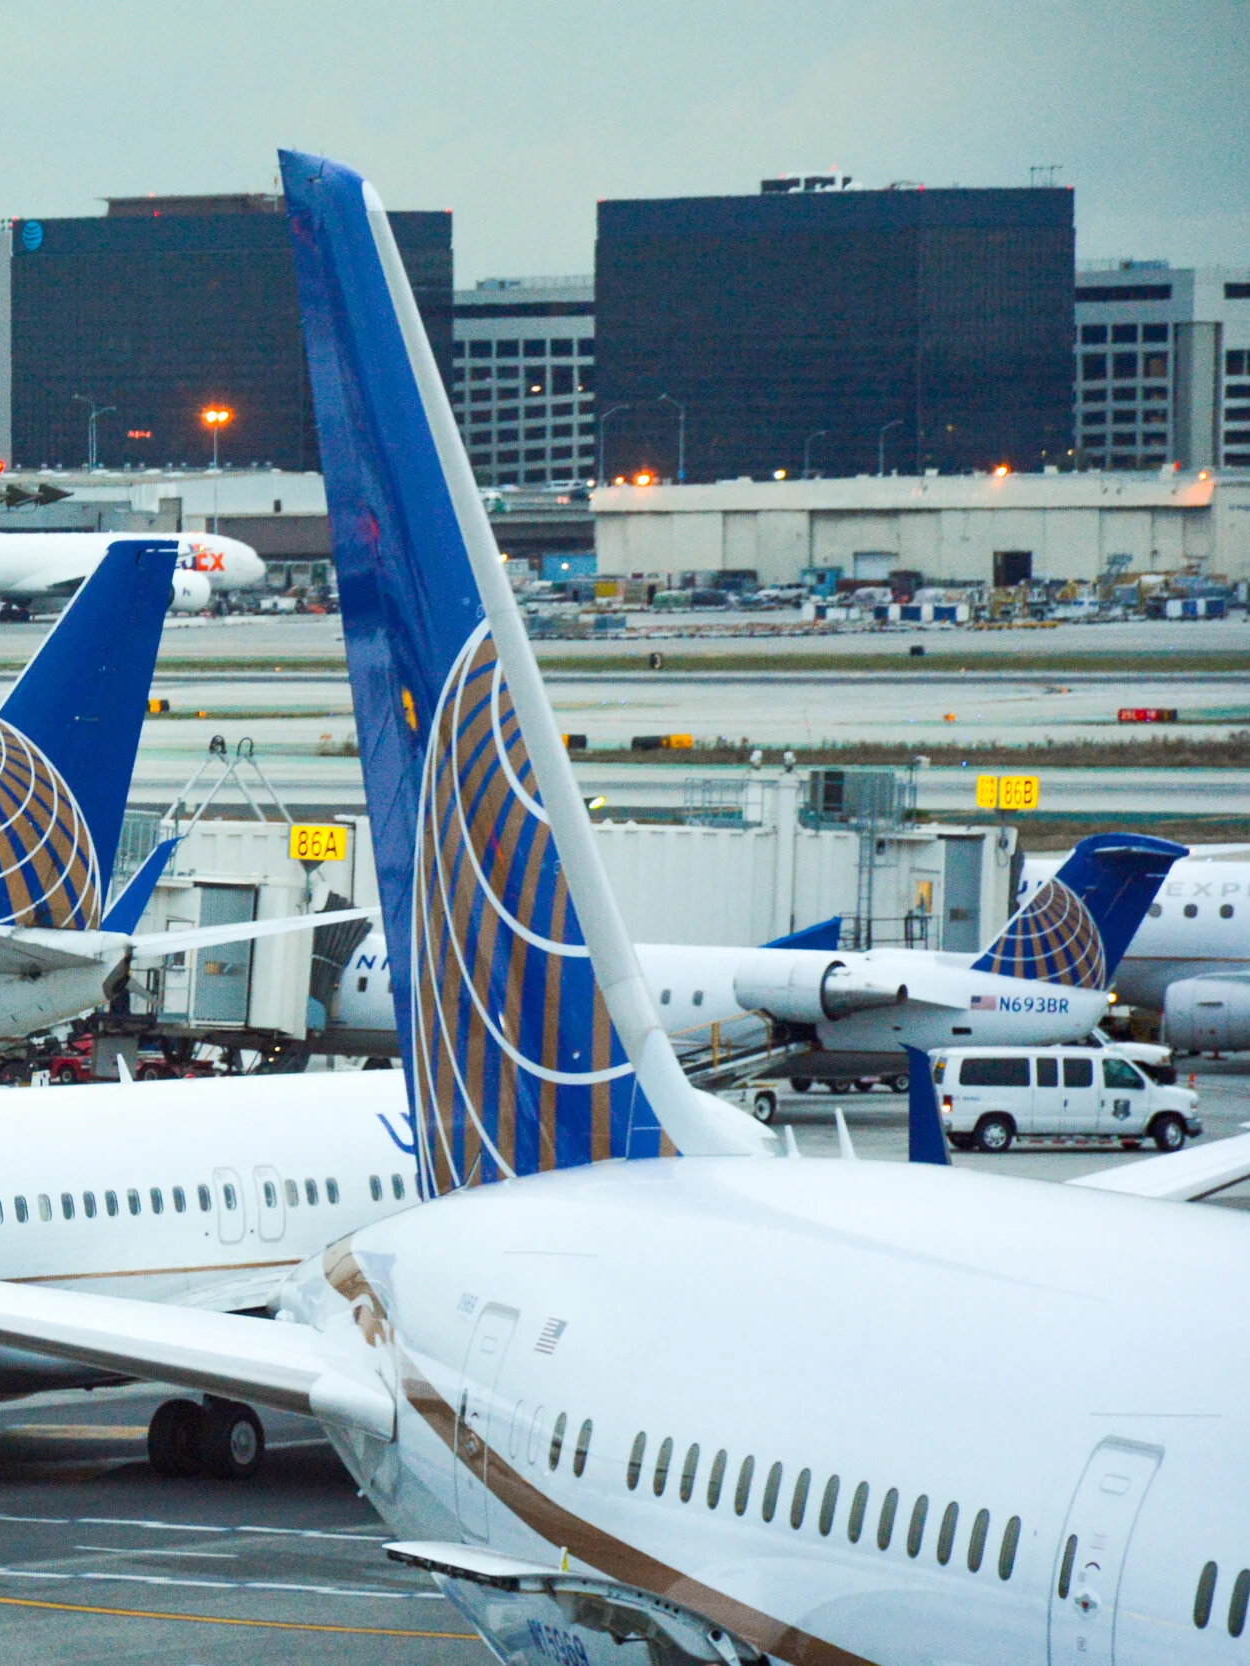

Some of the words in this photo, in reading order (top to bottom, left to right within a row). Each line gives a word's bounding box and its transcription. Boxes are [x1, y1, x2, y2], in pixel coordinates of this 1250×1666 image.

[1004, 780, 1033, 804] 86B
[297, 830, 338, 857] 86A
[1166, 881, 1250, 898] EXP
[999, 996, 1069, 1013] N693BR
